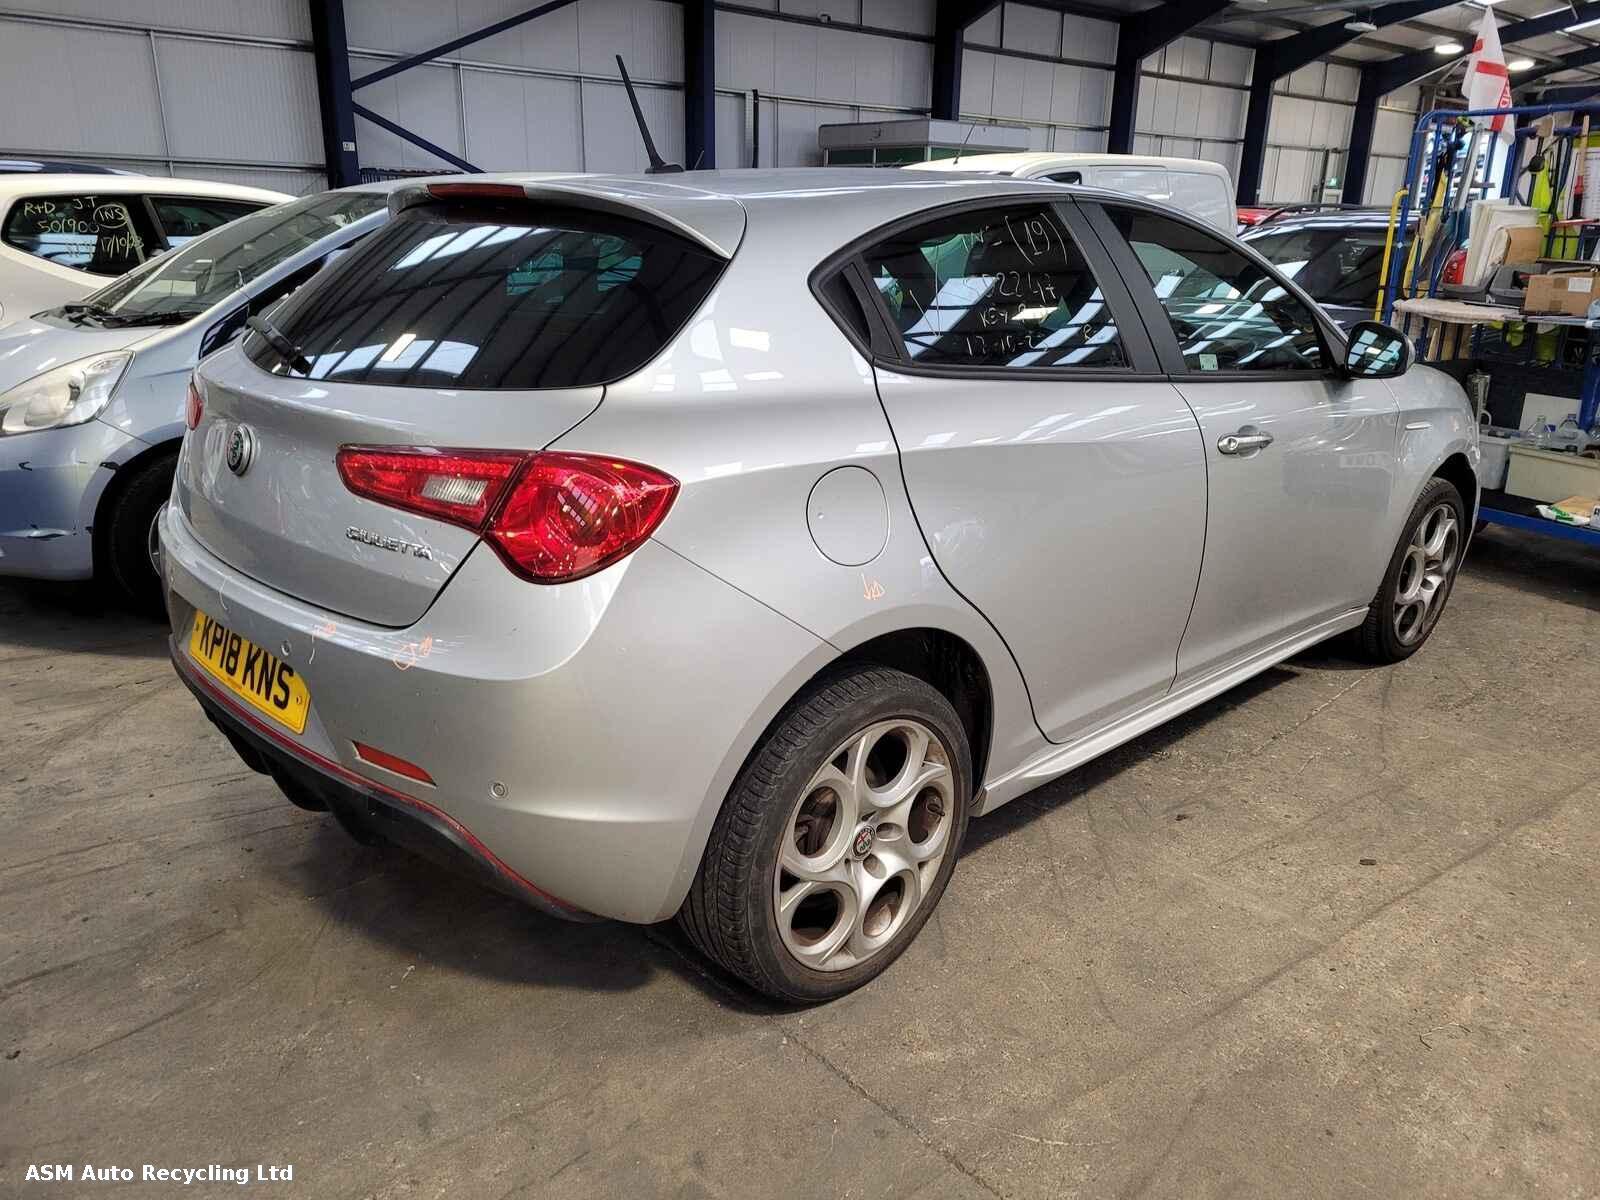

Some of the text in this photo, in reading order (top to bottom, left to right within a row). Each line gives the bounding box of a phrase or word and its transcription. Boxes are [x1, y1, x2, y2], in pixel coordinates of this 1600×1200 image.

[24, 201, 56, 216] R+D
[99, 207, 125, 221] INS
[200, 615, 294, 710] KP18 KNS
